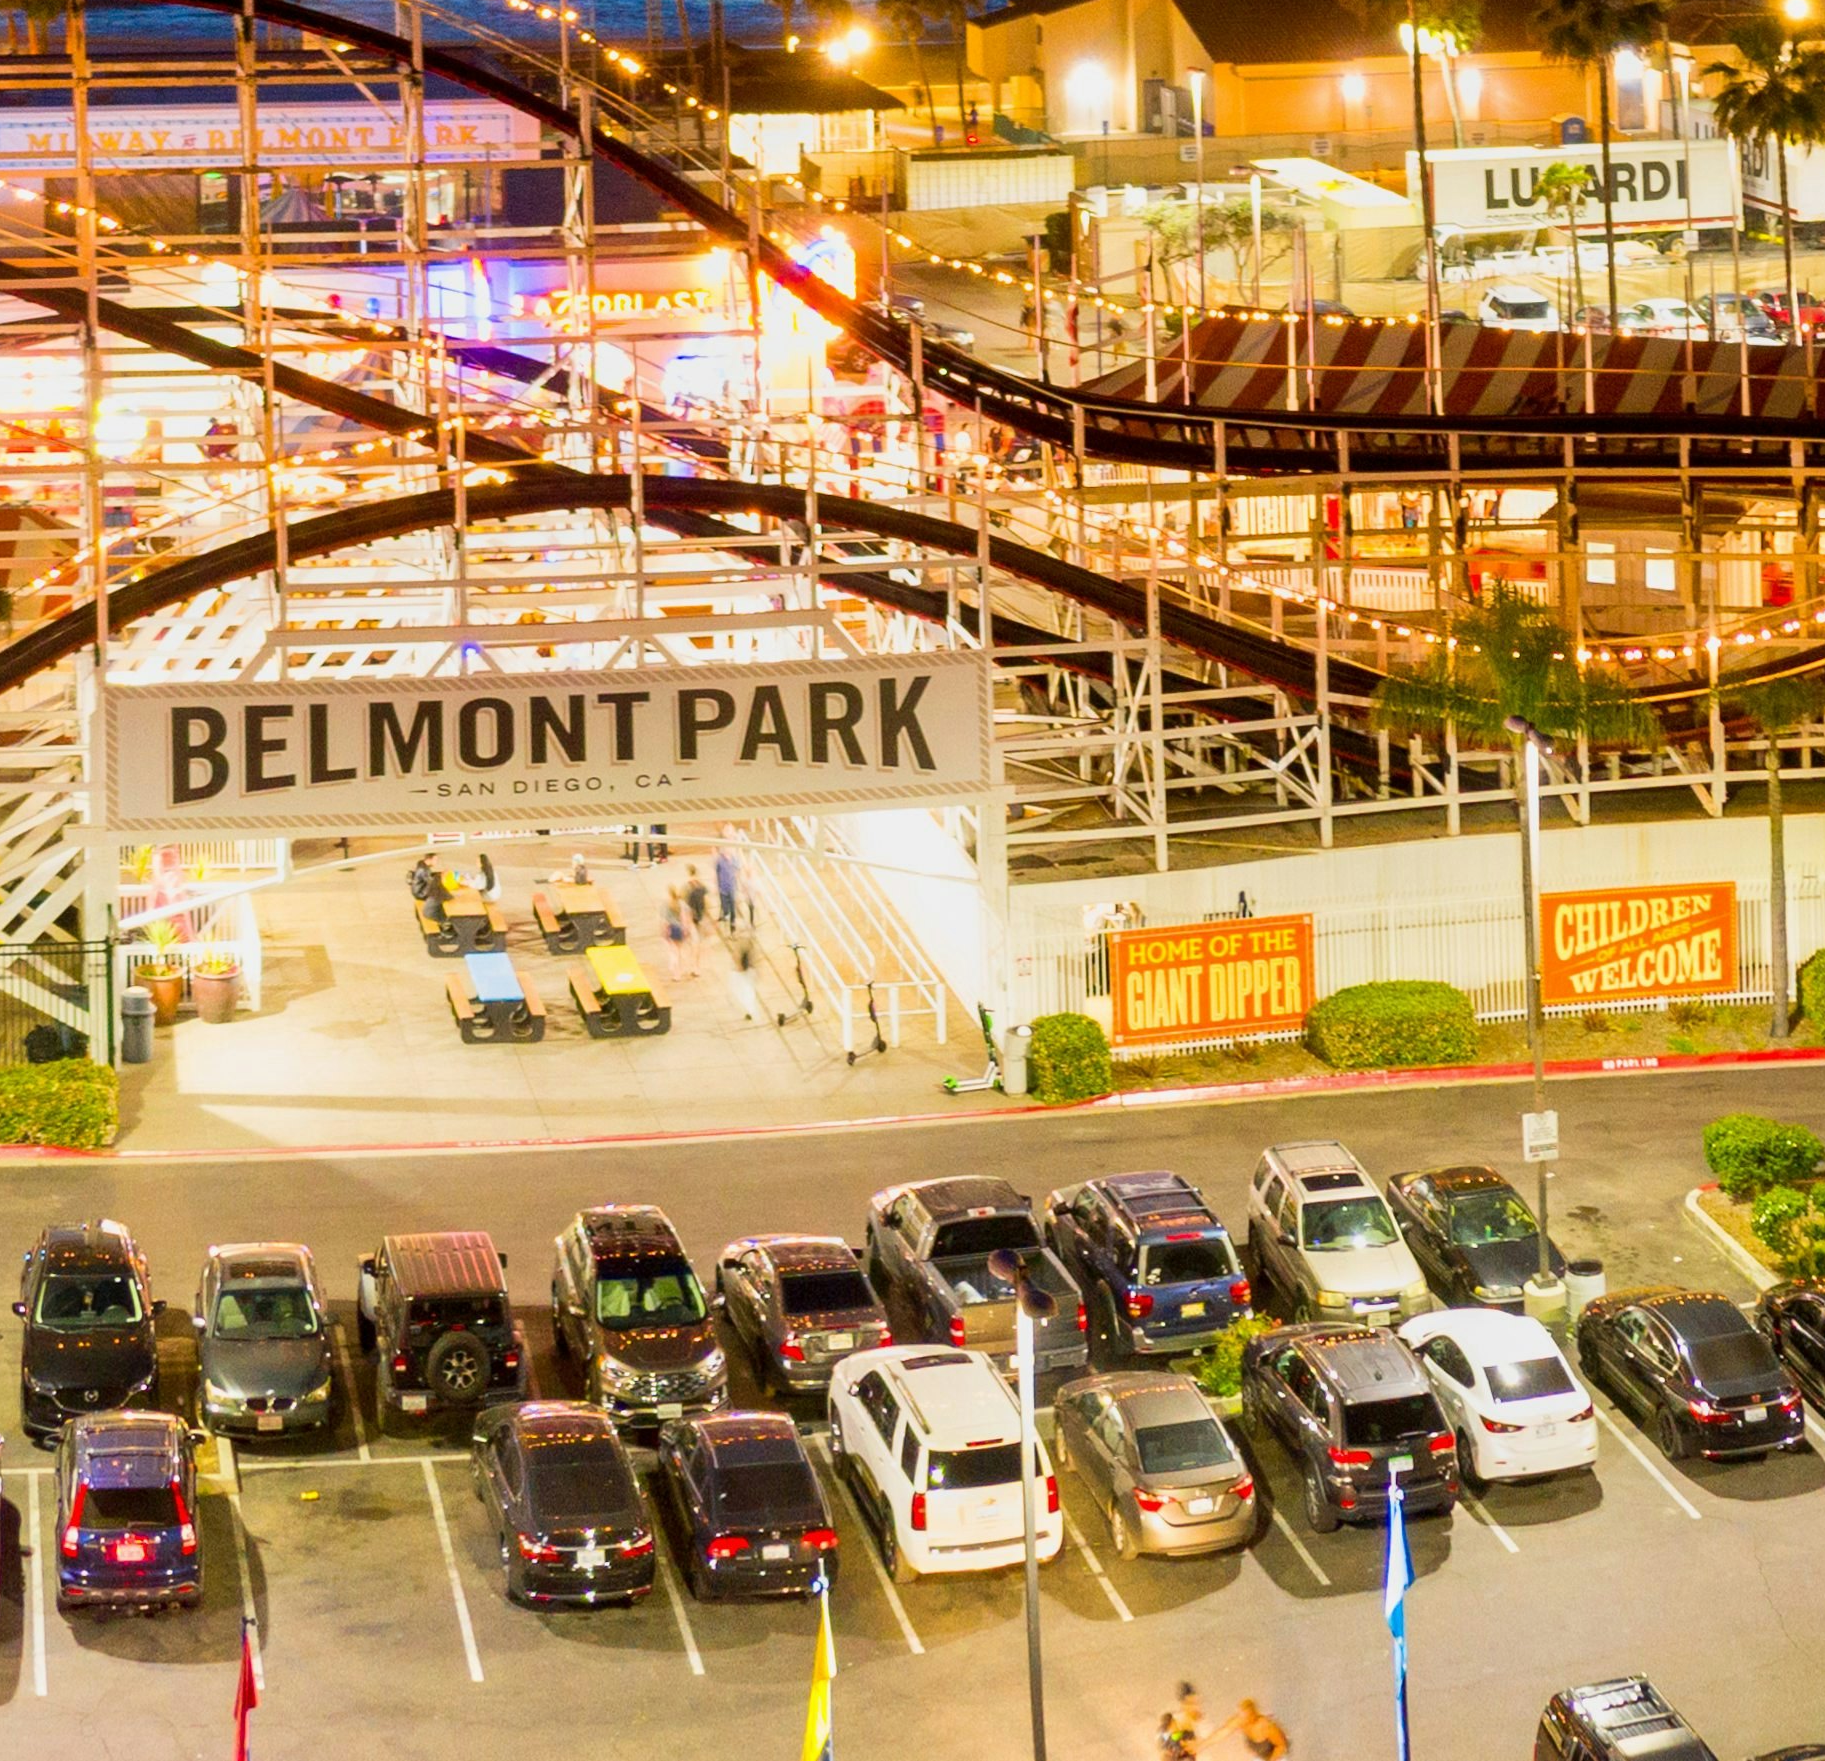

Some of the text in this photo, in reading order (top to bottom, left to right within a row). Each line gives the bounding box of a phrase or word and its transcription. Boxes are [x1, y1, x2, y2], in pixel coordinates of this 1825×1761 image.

[26, 130, 171, 152] MIWAY
[388, 124, 478, 148] PRK
[1485, 159, 1688, 209] LUARDI
[171, 675, 938, 806] BELMONT PARK
[437, 774, 673, 797] SAN DIEGO, CA
[1128, 928, 1297, 965] HOME OF THE
[1554, 894, 1713, 961] CHILDREN
[1569, 928, 1723, 994] WELCOME
[1127, 956, 1302, 1031] GIANT DIPPER
